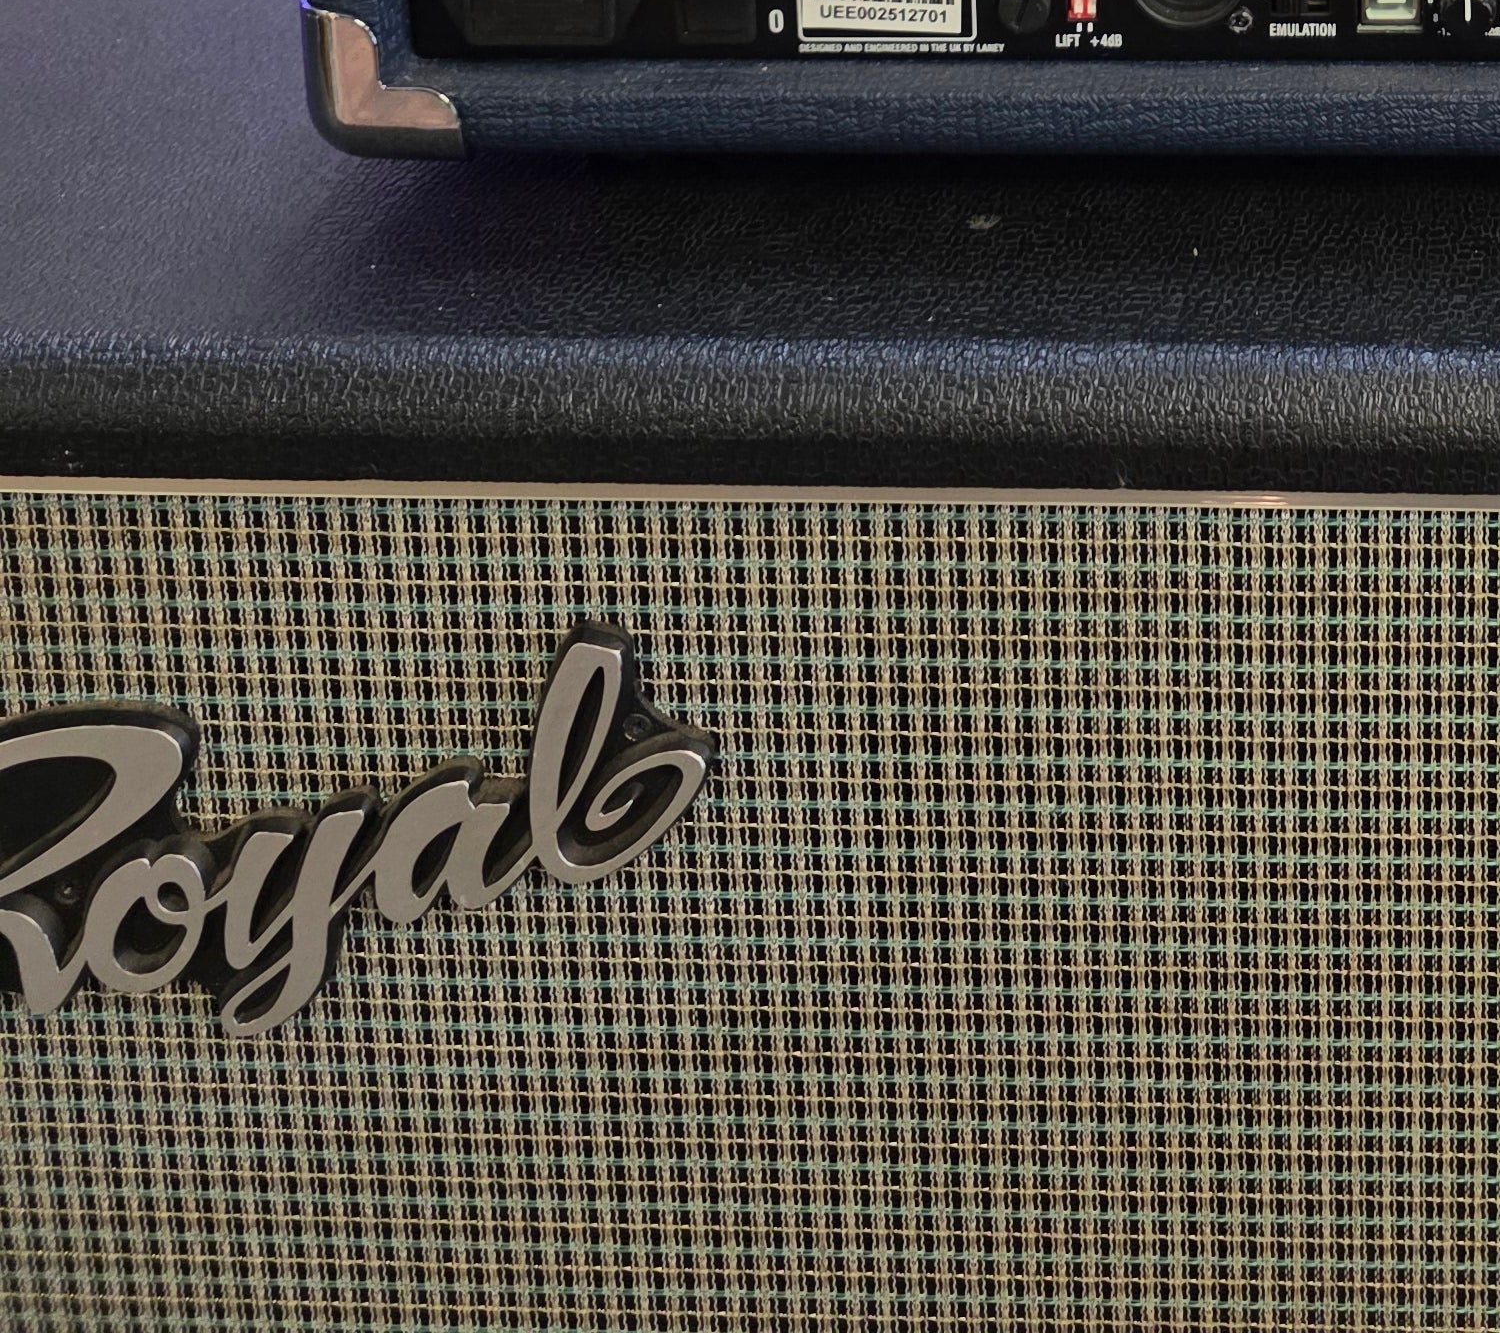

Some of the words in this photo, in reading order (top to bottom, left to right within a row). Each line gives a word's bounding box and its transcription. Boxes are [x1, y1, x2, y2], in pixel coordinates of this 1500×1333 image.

[820, 5, 947, 23] UEE002512701
[1269, 23, 1336, 37] EMULATION
[1055, 34, 1080, 47] LIFT
[1089, 34, 1122, 47] +4dB
[799, 43, 842, 53] DESIGNED
[844, 43, 862, 53] AND
[864, 43, 917, 53] ENGINEERED
[919, 43, 929, 53] IN
[931, 43, 947, 53] THE
[949, 43, 961, 53] UK
[963, 43, 974, 53] BY
[976, 43, 1005, 53] LANEY
